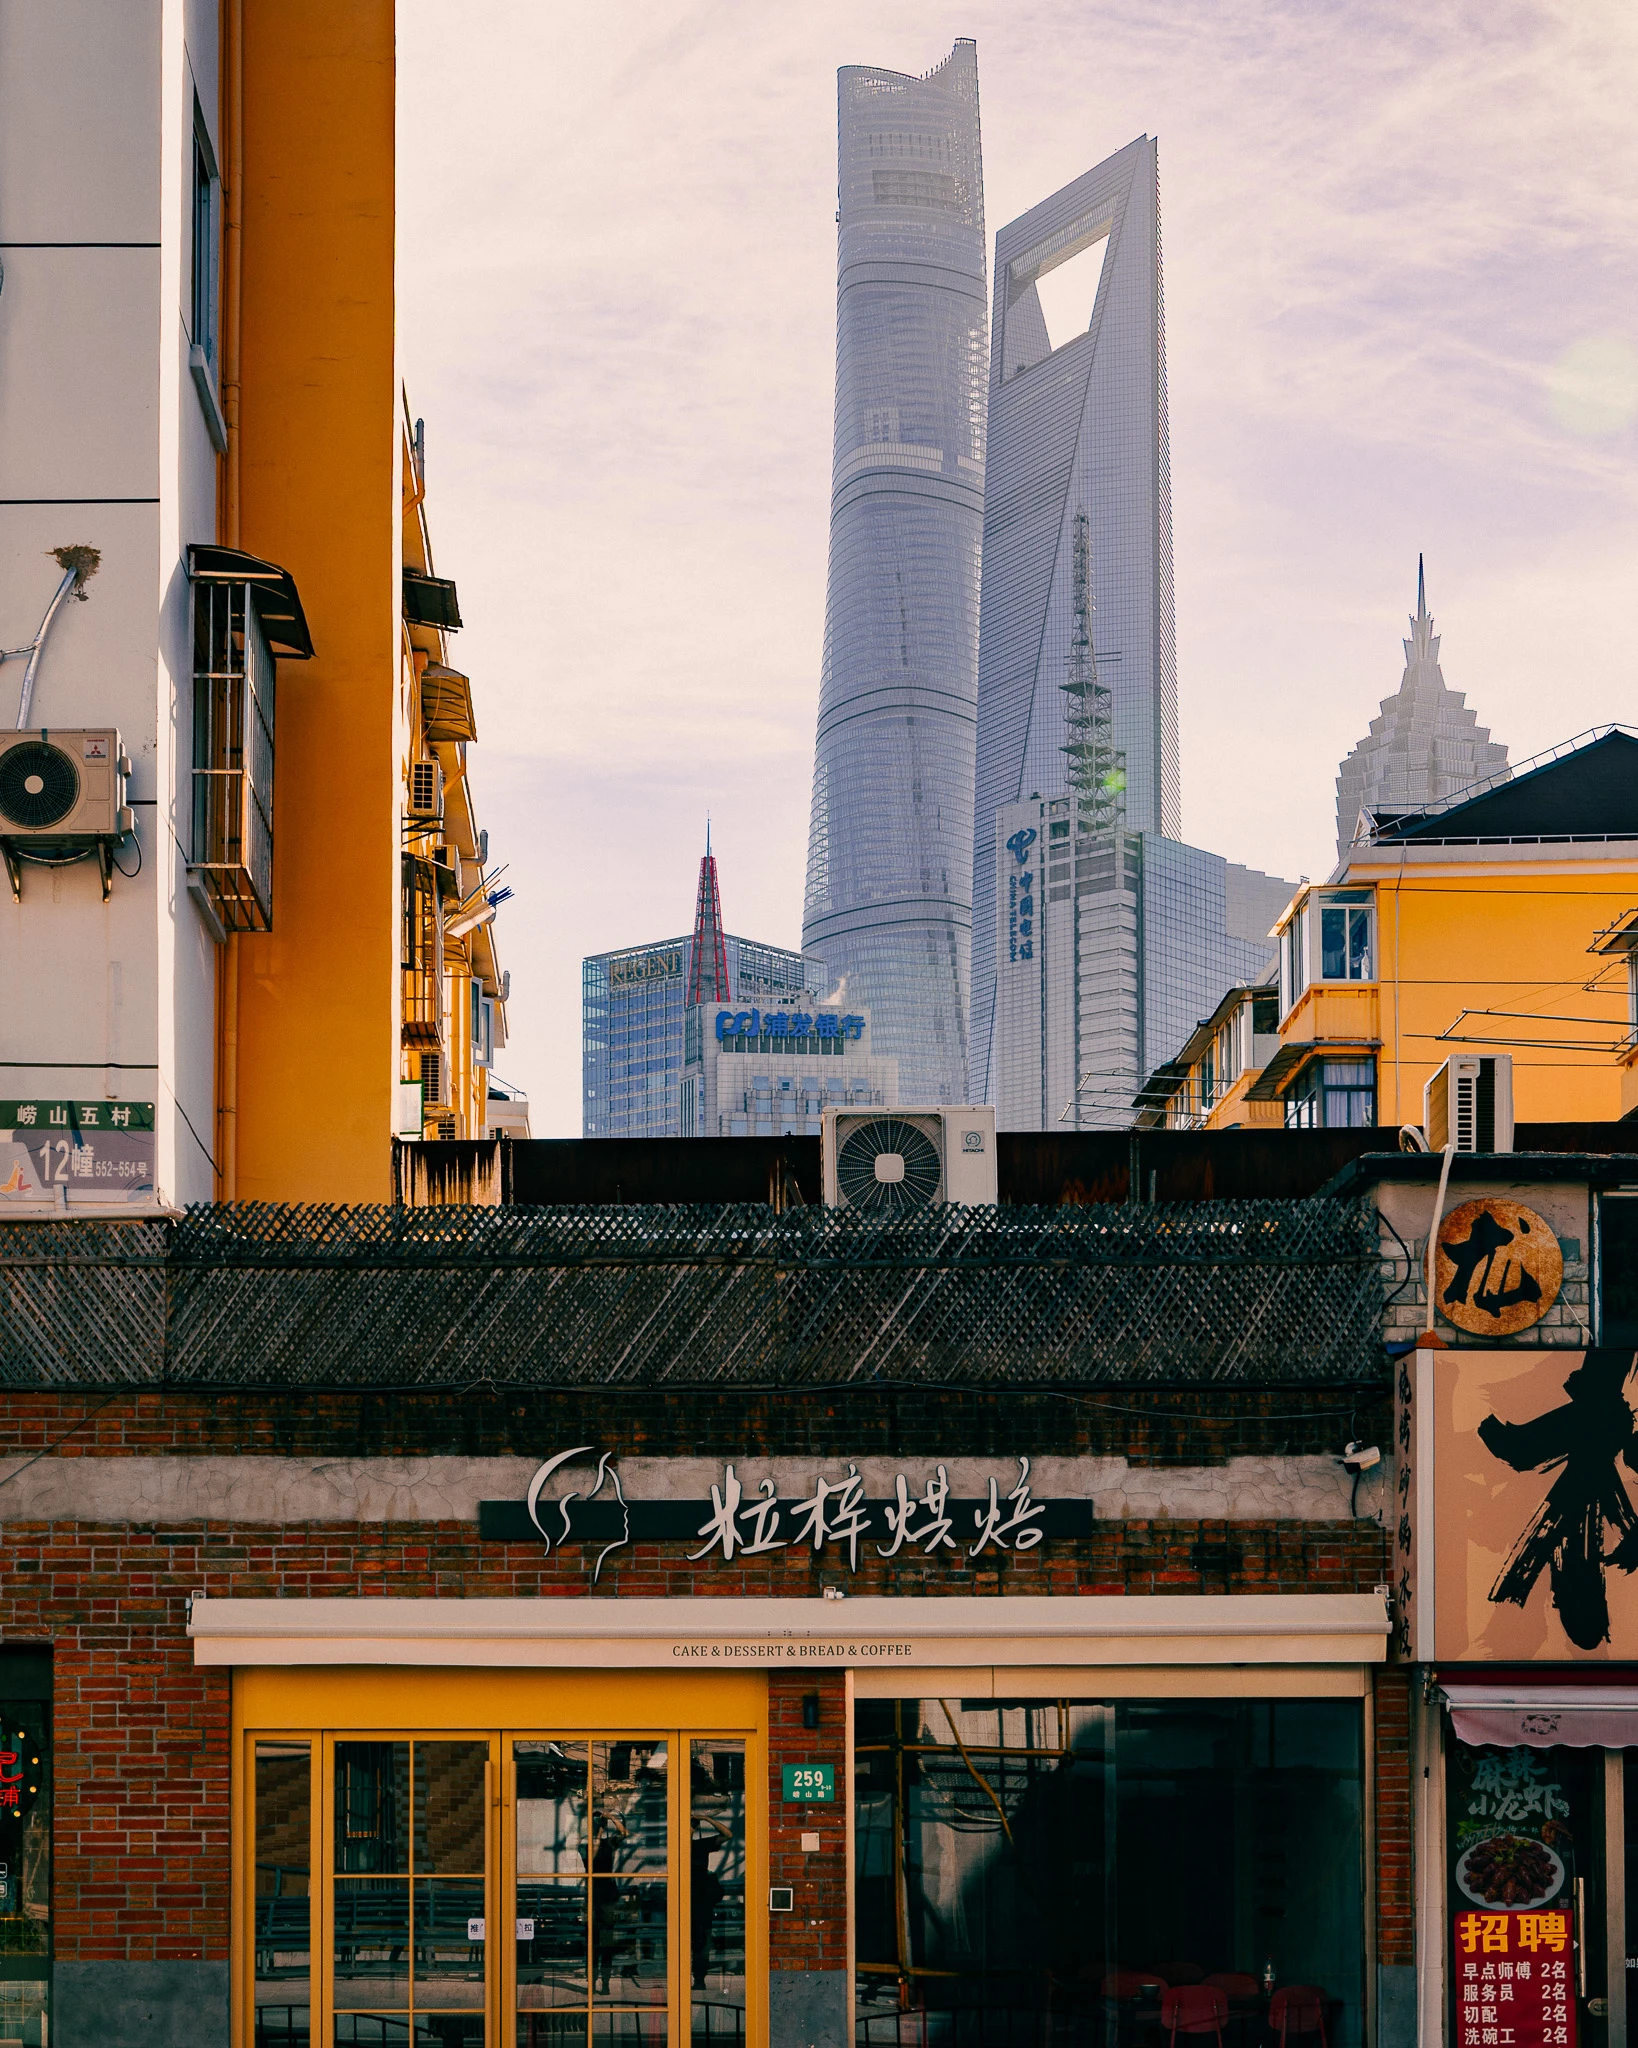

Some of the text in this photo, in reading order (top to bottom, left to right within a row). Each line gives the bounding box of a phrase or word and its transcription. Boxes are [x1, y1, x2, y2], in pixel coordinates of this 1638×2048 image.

[1009, 875, 1017, 962] CHINA TELECOM
[1019, 871, 1033, 960] 中国电信
[610, 951, 681, 985] REGENT
[763, 1012, 866, 1040] 浦发银行
[17, 1105, 131, 1127] 崂山五村
[39, 1140, 148, 1181] 12幢 552-554号
[686, 1456, 1046, 1574] 粒梓烘焙
[672, 1645, 912, 1657] CAKE & DESSERT & BREAD & COFFEE
[793, 1770, 824, 1786] 259
[1471, 1747, 1548, 1799] 麻辣
[1468, 1778, 1566, 1820] 小龙虾
[470, 1924, 479, 1932] 推
[524, 1923, 532, 1932] 拉
[1460, 1912, 1568, 1953] 招聘
[1463, 1961, 1566, 1980] 早点师傅 2名
[1463, 1983, 1567, 2002] 服务员 2名
[1464, 2004, 1567, 2024] 切配 2名
[1464, 2026, 1568, 2045] 洗碗工 2名
